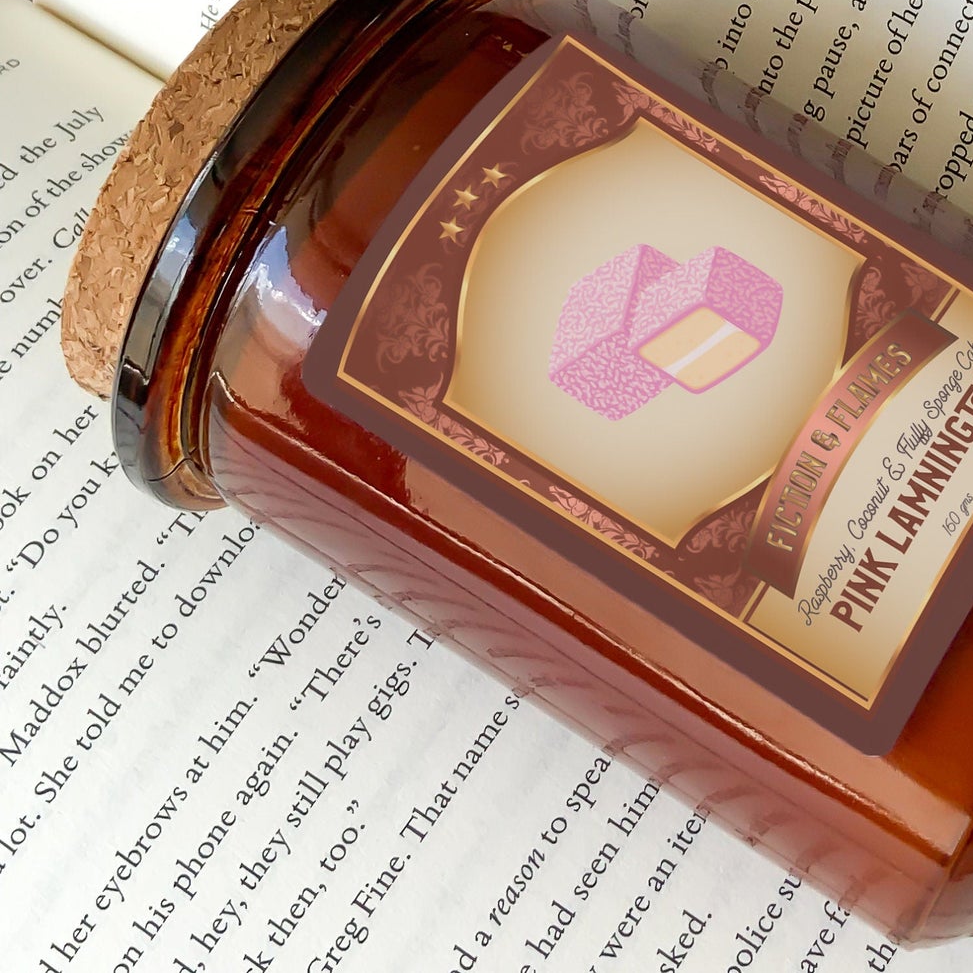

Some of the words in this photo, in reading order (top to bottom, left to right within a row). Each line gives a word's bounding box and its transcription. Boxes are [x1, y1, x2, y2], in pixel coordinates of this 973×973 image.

[200, 2, 222, 32] He
[753, 53, 784, 96] nto
[771, 10, 804, 51] the
[812, 22, 860, 100] pause,
[19, 137, 57, 164] the
[54, 106, 104, 142] July
[24, 189, 50, 218] of
[45, 169, 83, 198] the
[0, 257, 53, 304] over.
[825, 342, 912, 432] FLAMES
[30, 450, 63, 481] on
[51, 404, 100, 446] her
[810, 429, 841, 451] &
[5, 527, 60, 573] “Do
[56, 477, 102, 529] you
[766, 451, 828, 552] FICTION
[798, 544, 856, 626] Raspberry,
[847, 477, 890, 540] Coconut
[896, 418, 933, 459] Fluffy
[923, 368, 963, 419] Sponge
[941, 510, 961, 537] 160
[959, 491, 973, 517] gms
[829, 546, 899, 633] PINK
[0, 656, 89, 768] Maddox
[74, 559, 166, 655] blurted.
[0, 813, 42, 857] lot.
[33, 755, 79, 804] She
[75, 692, 122, 751] told
[117, 653, 155, 697] me
[150, 622, 179, 650] to
[184, 754, 210, 784] at
[196, 696, 259, 755] him.
[131, 897, 176, 942] his
[172, 809, 237, 901] phone
[235, 731, 299, 807] again.
[288, 614, 382, 711] “There’s
[189, 898, 248, 954] hey,
[238, 827, 292, 891] they
[285, 769, 330, 829] still
[323, 715, 372, 781] play
[366, 660, 418, 722] gigs.
[349, 853, 412, 919] Fine.
[397, 779, 458, 844] That
[451, 710, 509, 782] name
[94, 785, 189, 911] eyebrows
[266, 882, 328, 948] then,
[318, 798, 366, 872] too.”
[474, 930, 493, 948] a
[488, 847, 546, 927] reason
[539, 816, 568, 845] to
[49, 913, 97, 963] her
[523, 899, 577, 960] had
[572, 842, 621, 902] seen
[598, 894, 651, 959] were
[647, 858, 678, 893] an
